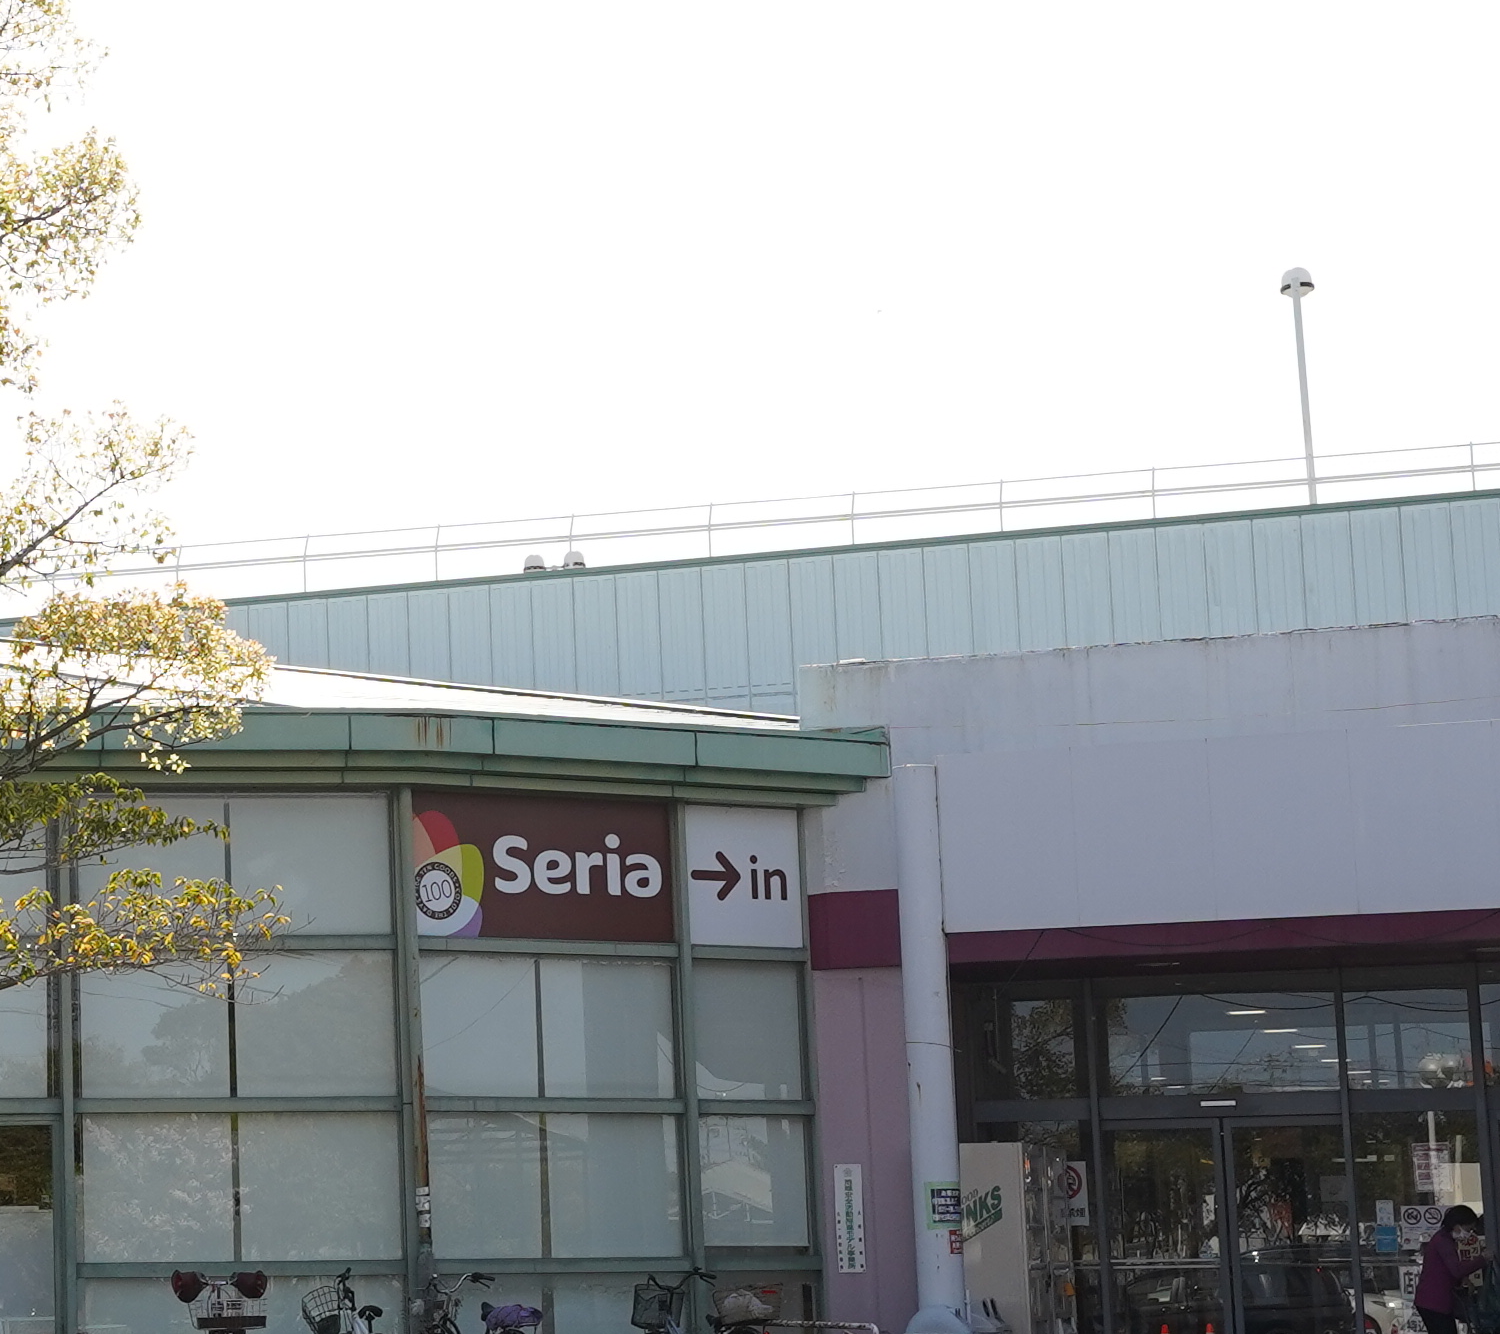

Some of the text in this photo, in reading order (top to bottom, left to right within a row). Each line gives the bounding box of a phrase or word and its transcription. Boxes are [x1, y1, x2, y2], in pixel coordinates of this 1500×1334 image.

[492, 833, 662, 898] Seria
[750, 854, 788, 901] in
[421, 879, 453, 903] 100
[961, 1188, 979, 1205] OOD
